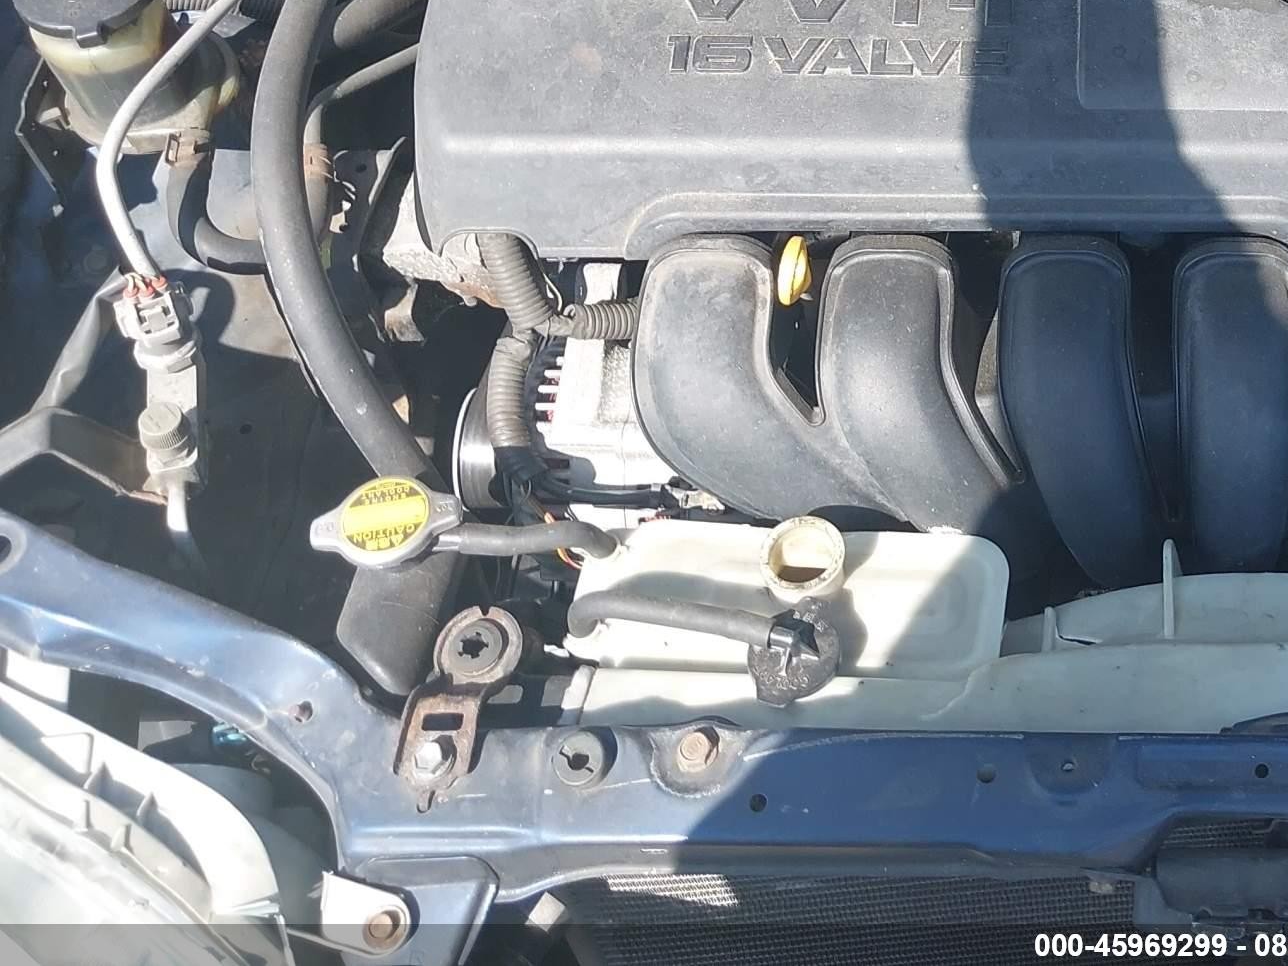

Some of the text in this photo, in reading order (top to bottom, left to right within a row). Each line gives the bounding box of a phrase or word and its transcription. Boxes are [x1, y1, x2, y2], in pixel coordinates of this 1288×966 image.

[667, 35, 1008, 76] 16 VALVE
[353, 523, 416, 544] CAUTION
